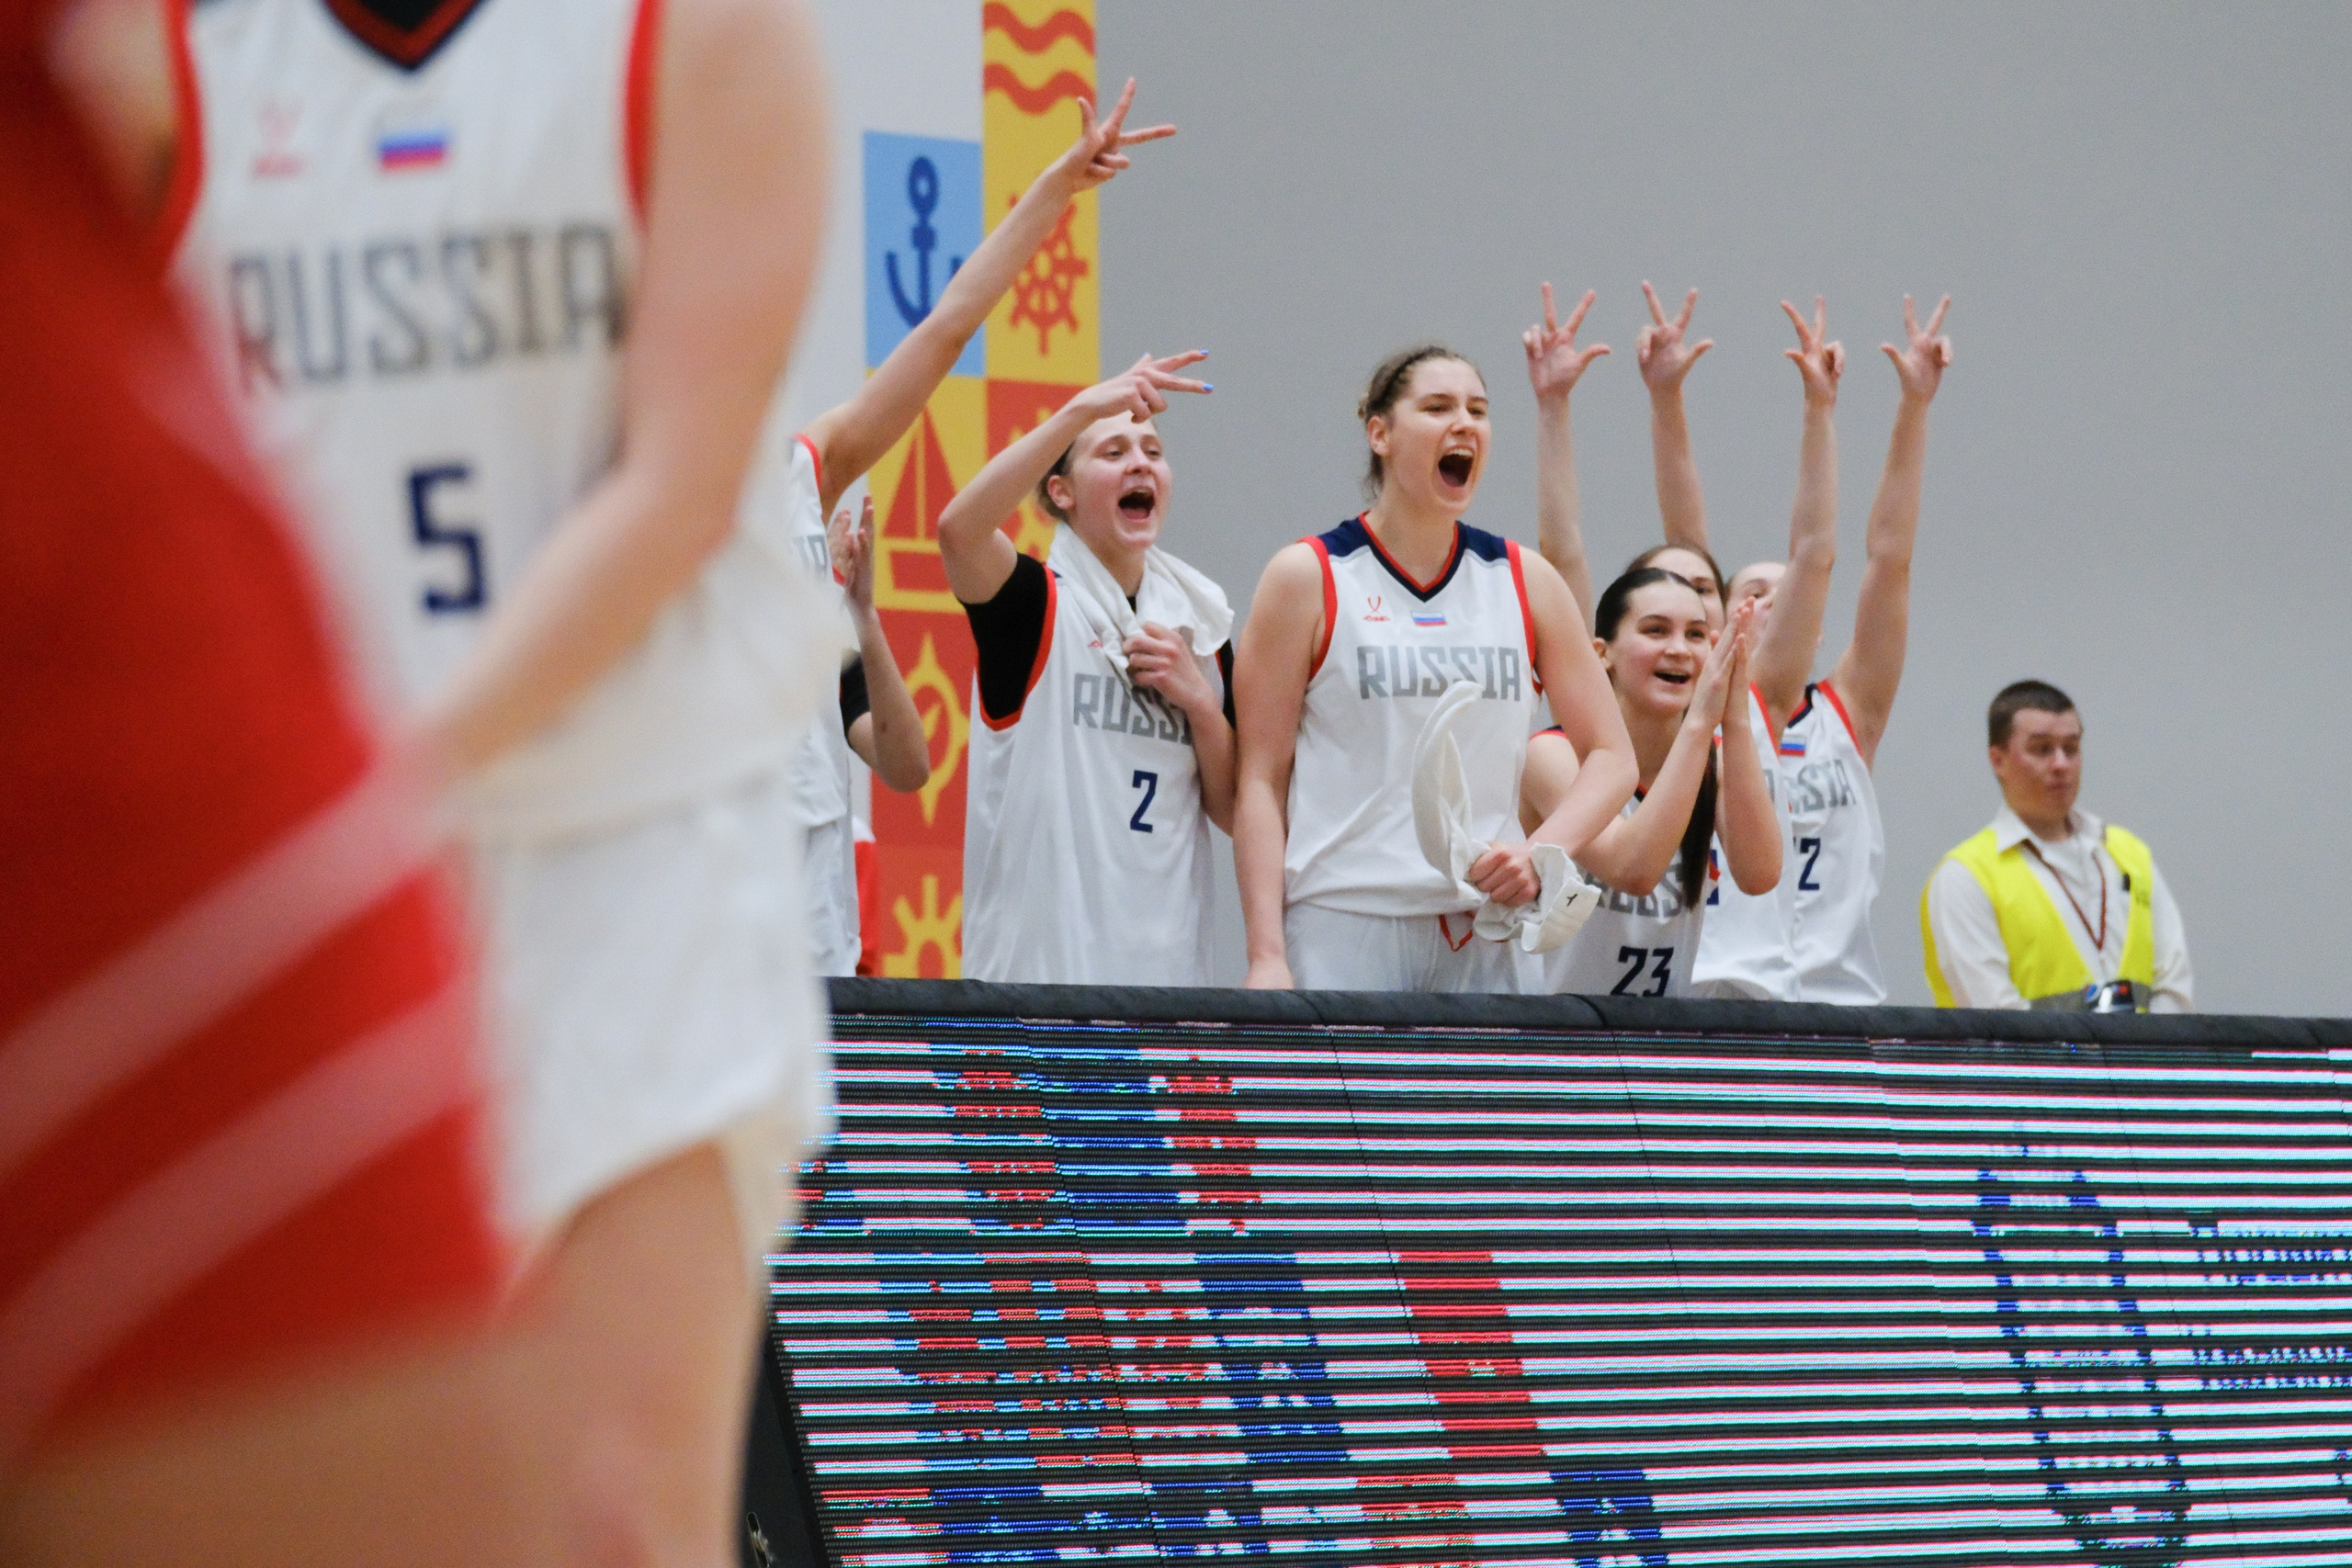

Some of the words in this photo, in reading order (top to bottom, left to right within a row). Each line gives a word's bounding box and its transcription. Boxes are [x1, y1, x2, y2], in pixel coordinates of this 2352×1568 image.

[229, 222, 628, 393] RUSSIA
[406, 461, 488, 616] 5
[1357, 645, 1521, 702] RUSSIA
[1073, 672, 1193, 745] RUSS
[1130, 770, 1158, 833] 2
[1793, 837, 1821, 891] 2
[1610, 945, 1674, 997] 23
